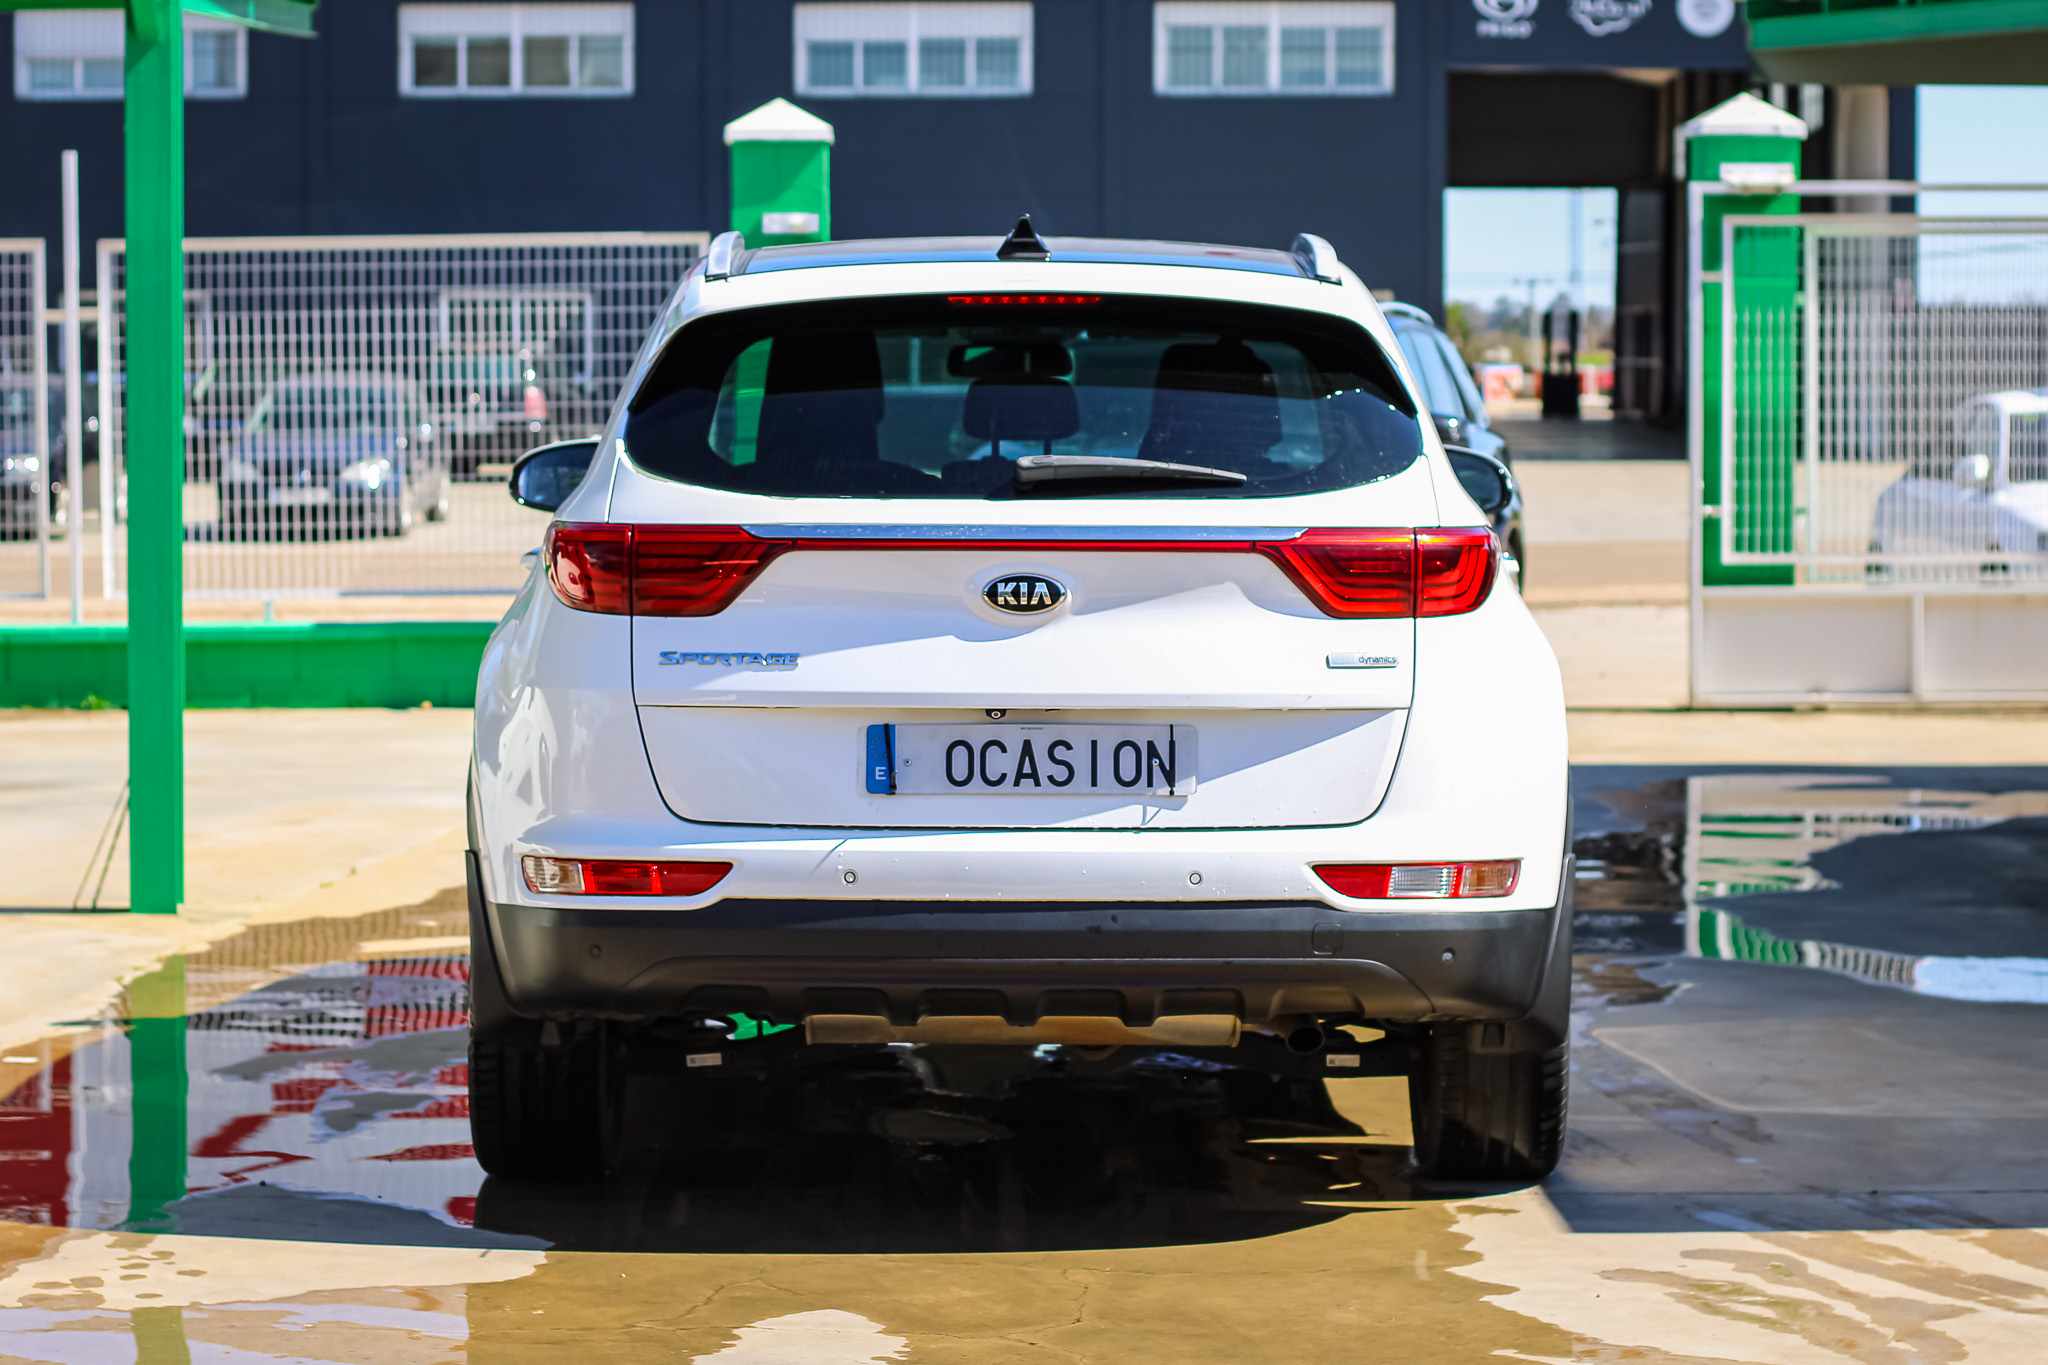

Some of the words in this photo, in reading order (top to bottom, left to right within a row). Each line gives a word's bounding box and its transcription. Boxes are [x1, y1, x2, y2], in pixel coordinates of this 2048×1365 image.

[996, 582, 1052, 605] KIA
[658, 651, 800, 666] SPORTAGE
[875, 766, 886, 780] E
[945, 739, 1176, 788] OCASION
